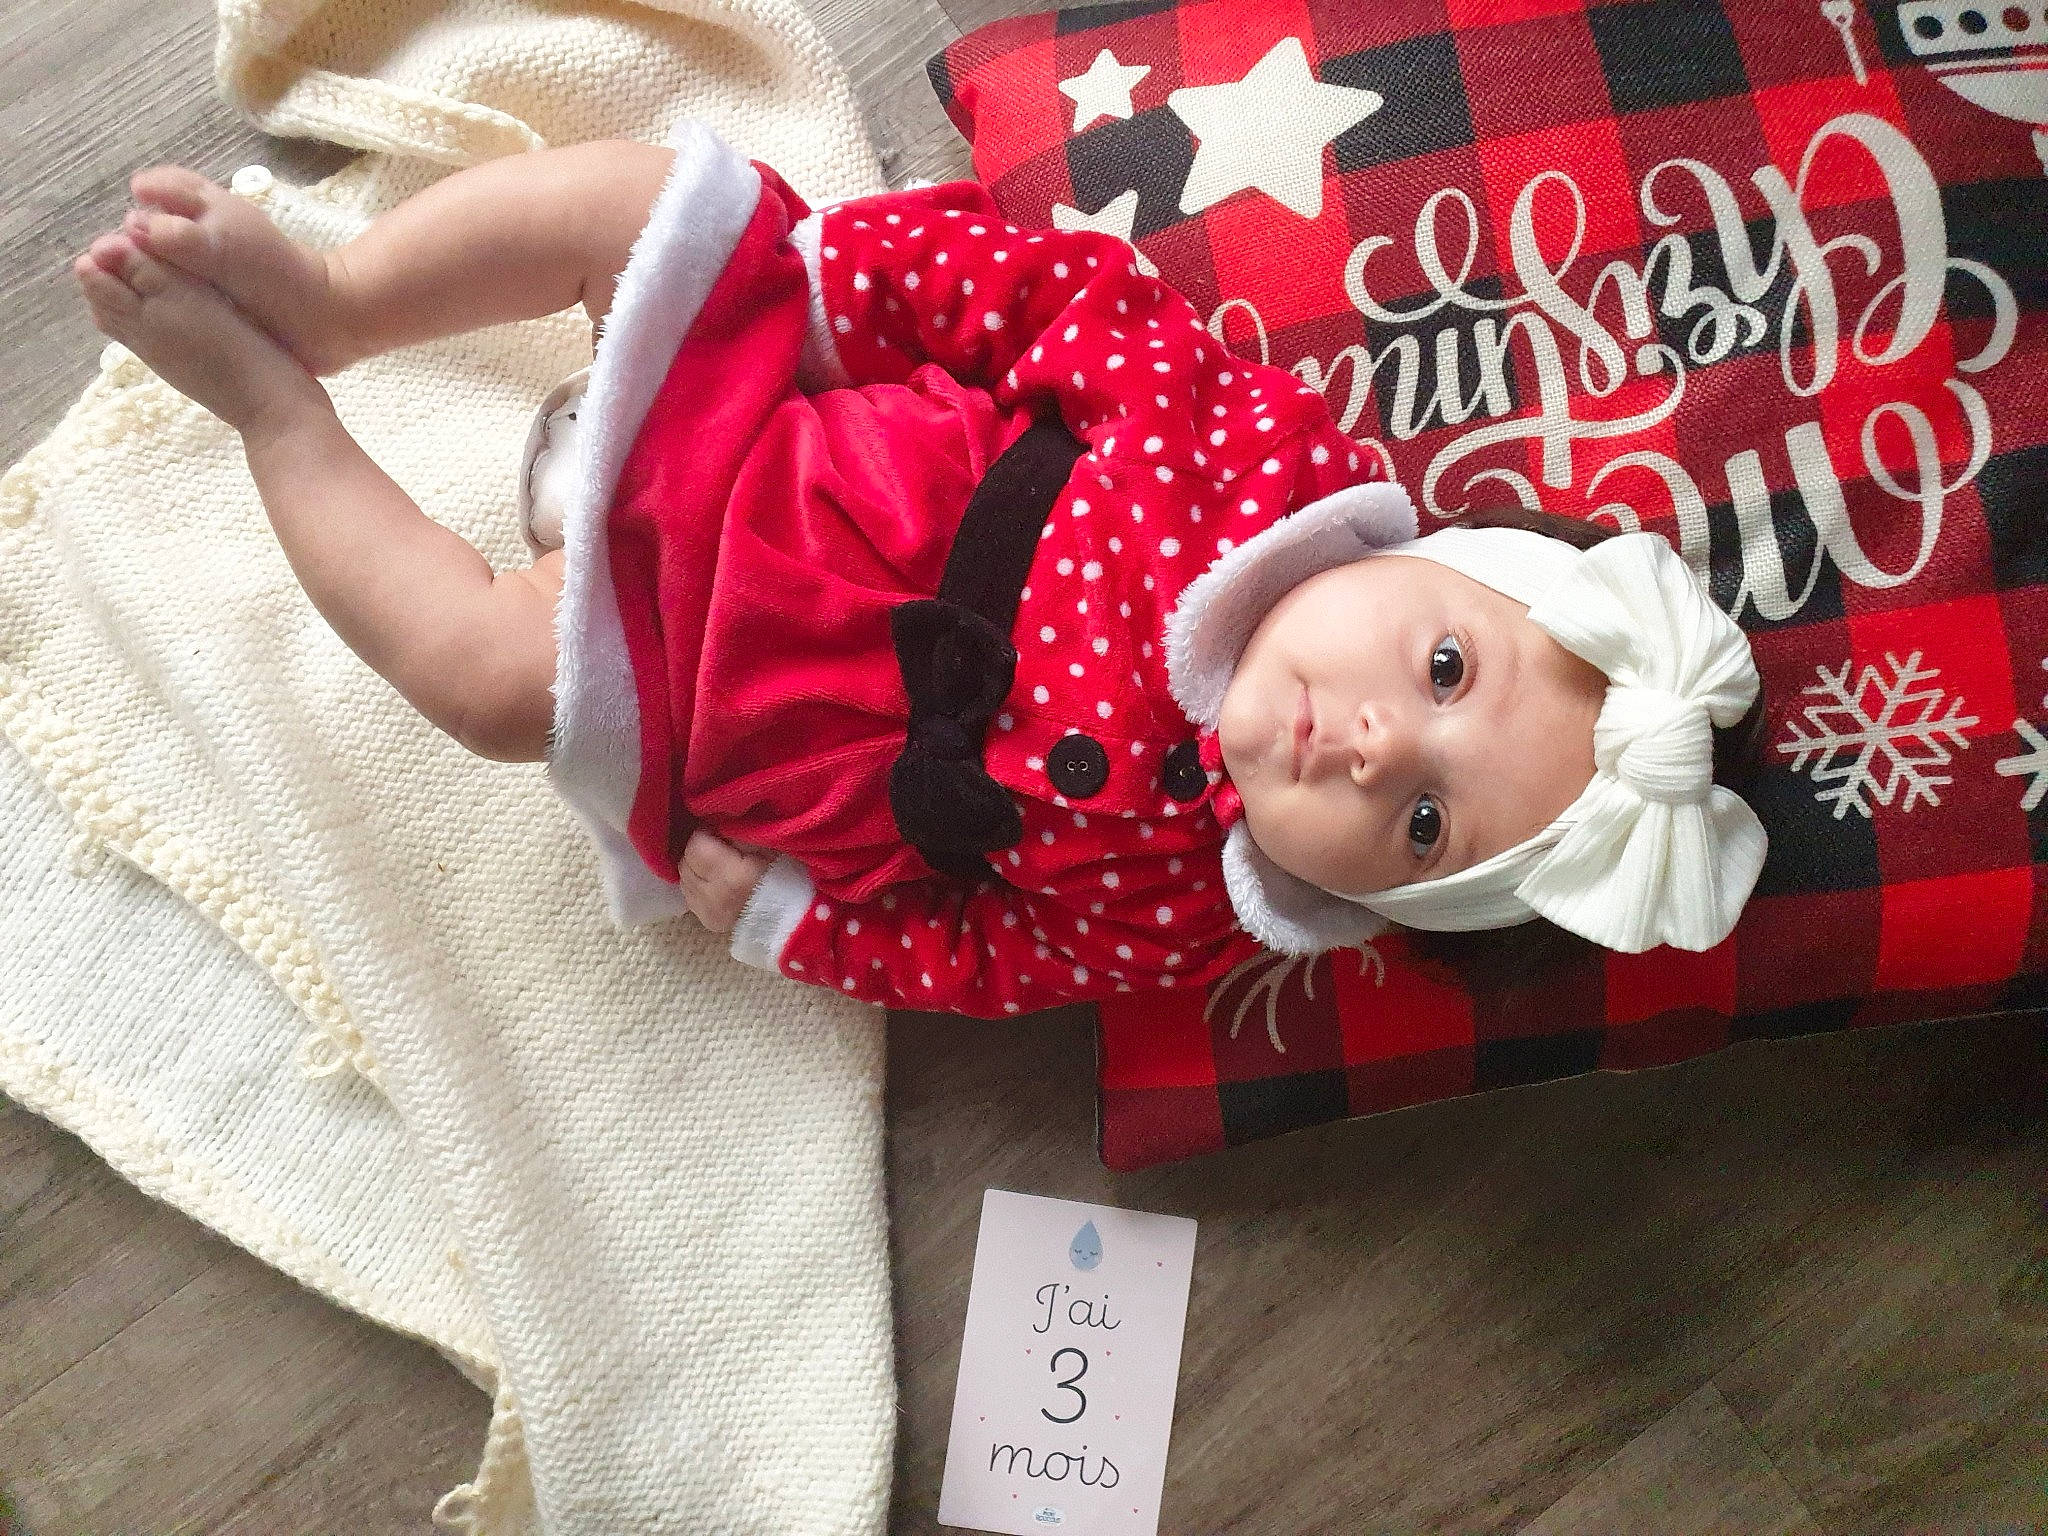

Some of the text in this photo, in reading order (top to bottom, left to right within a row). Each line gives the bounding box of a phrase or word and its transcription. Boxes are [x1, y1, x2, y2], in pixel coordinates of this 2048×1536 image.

[1032, 1282, 1122, 1334] J'ai
[1040, 1346, 1089, 1424] 3
[989, 1443, 1120, 1489] mois
